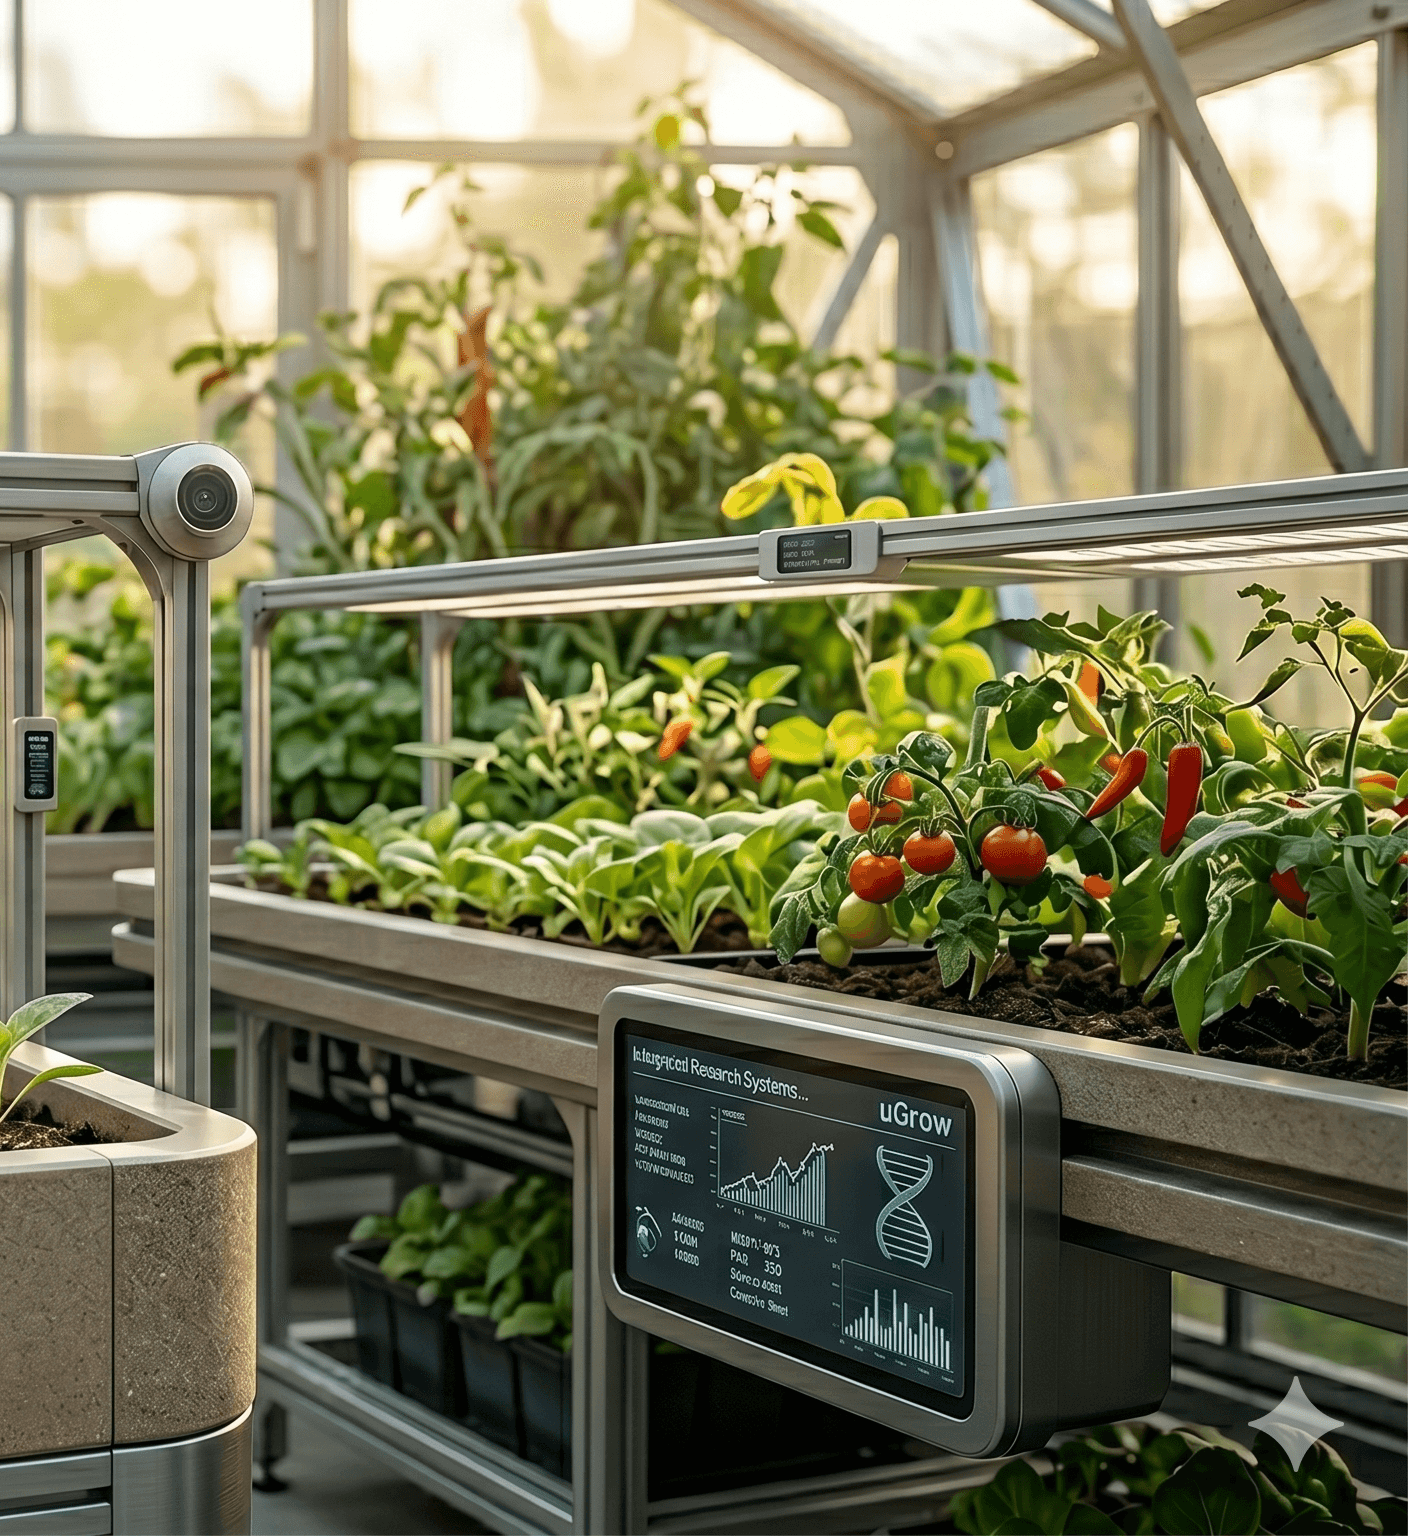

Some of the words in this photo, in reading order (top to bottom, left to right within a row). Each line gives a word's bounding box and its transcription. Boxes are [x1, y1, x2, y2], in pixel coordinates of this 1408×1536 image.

[743, 1070, 809, 1101] Systems...
[880, 1101, 952, 1137] uGrow
[764, 1260, 782, 1277] 350
